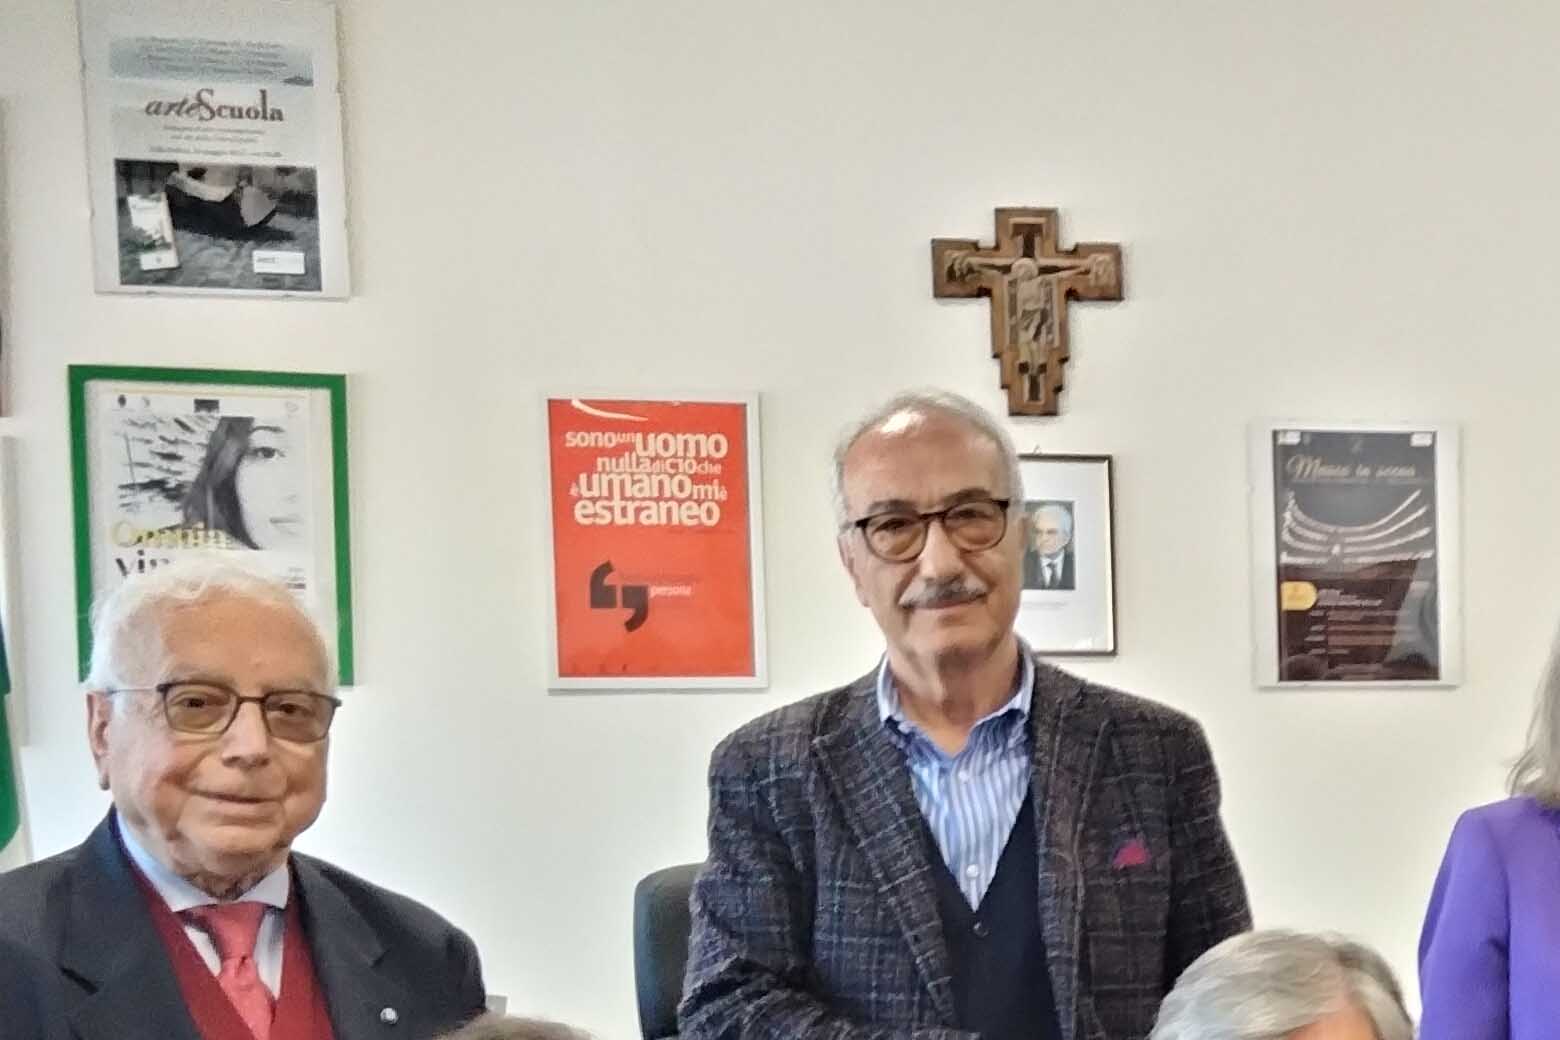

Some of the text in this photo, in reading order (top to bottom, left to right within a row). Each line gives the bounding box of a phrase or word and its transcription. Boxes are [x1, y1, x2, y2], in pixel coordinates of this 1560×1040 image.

[145, 88, 284, 122] arteScuola
[565, 431, 617, 447] sono
[636, 432, 728, 458] uomo
[597, 452, 651, 472] nulla
[579, 473, 692, 498] umano
[693, 478, 719, 500] mi
[574, 499, 721, 527] estraneo
